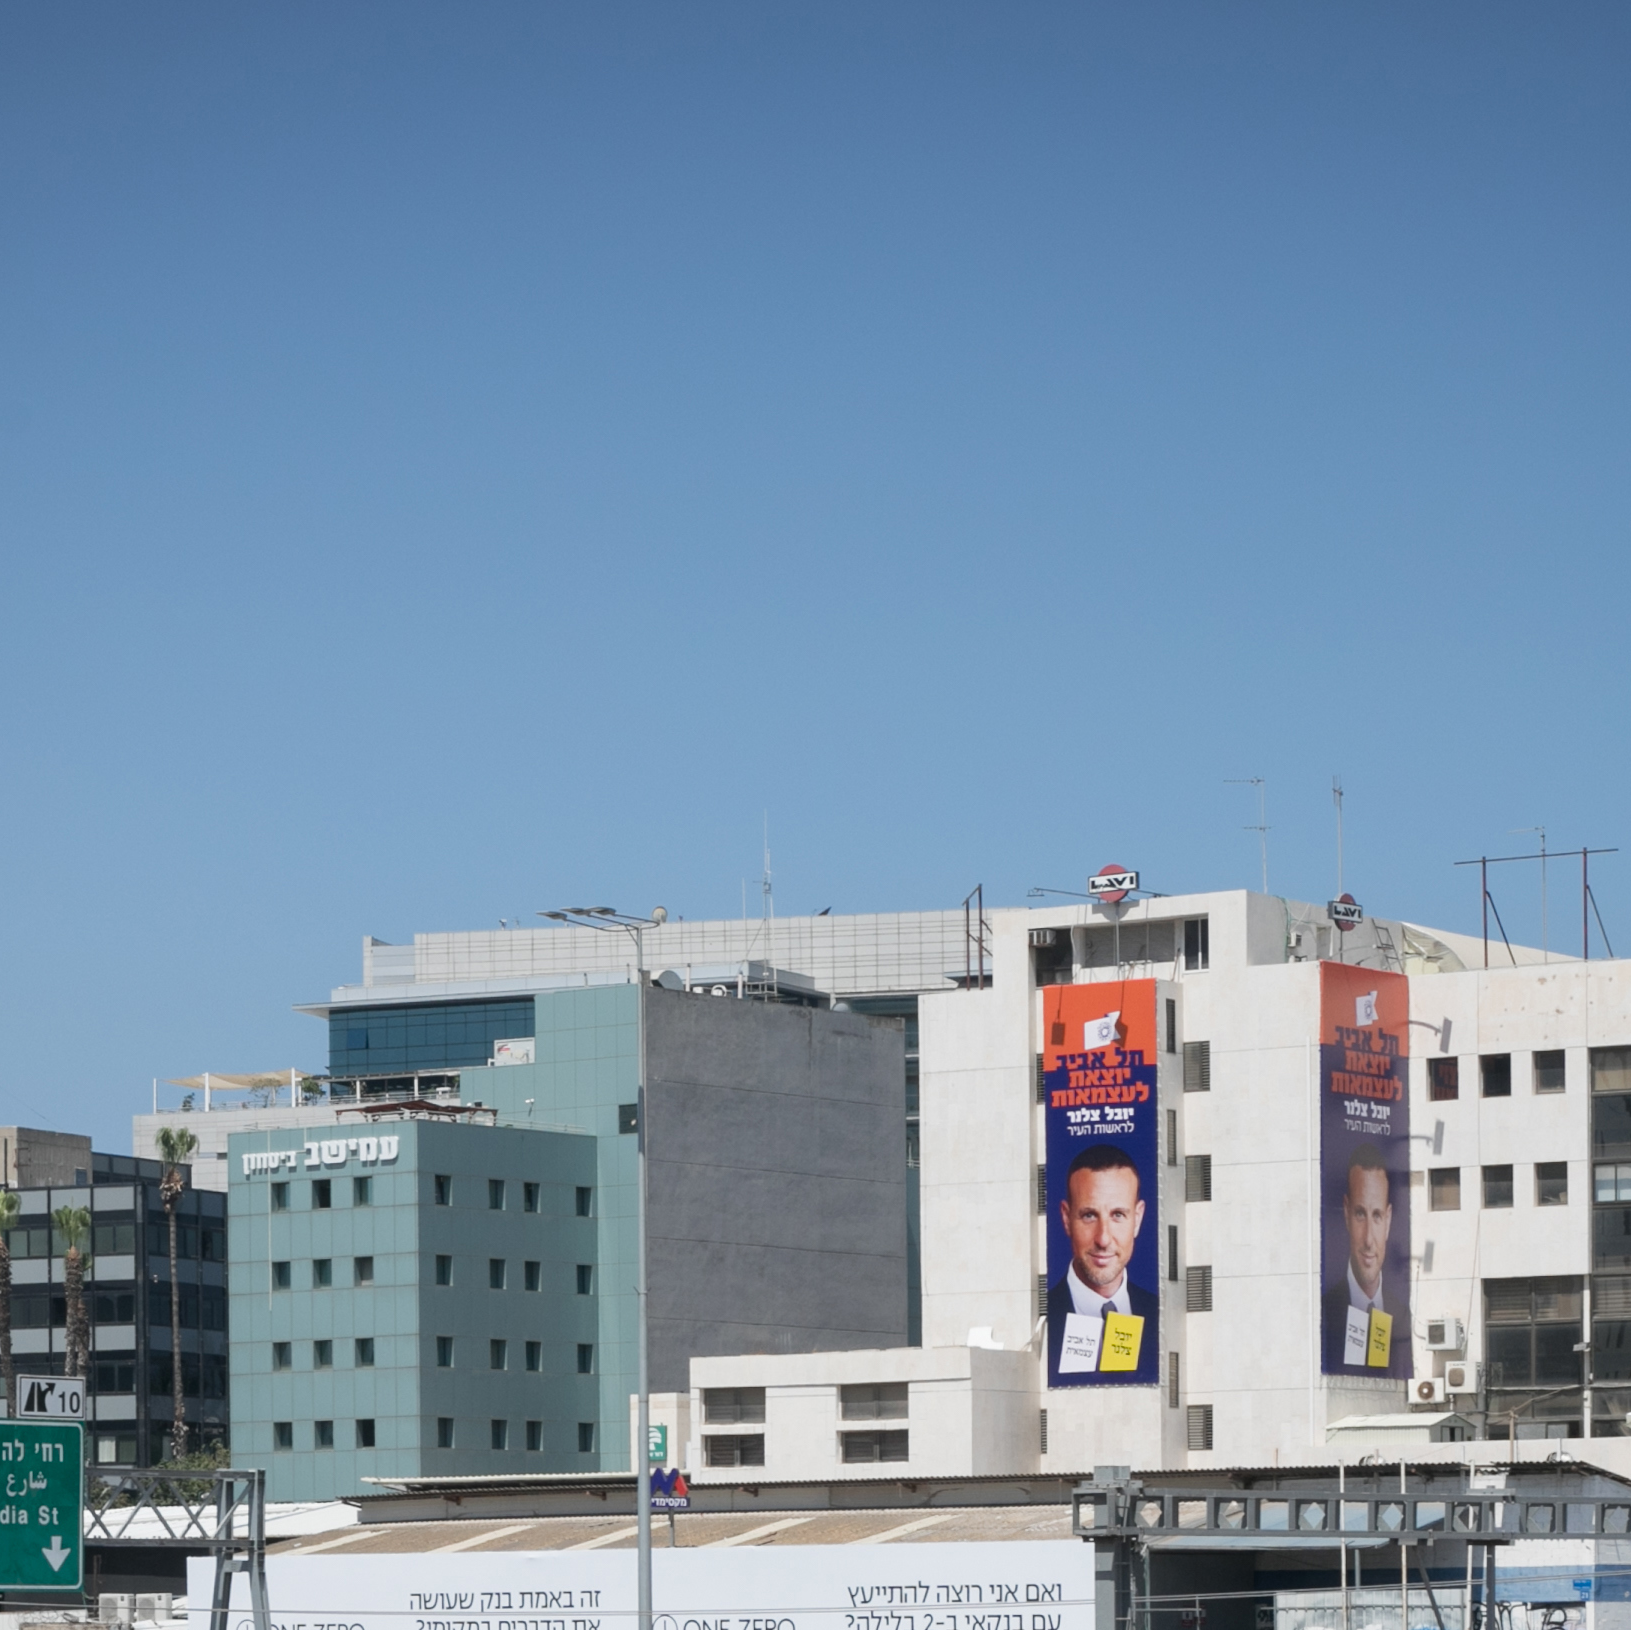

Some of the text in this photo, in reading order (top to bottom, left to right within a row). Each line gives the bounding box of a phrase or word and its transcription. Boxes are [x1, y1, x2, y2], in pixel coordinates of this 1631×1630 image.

[1090, 875, 1135, 891] LAVI
[1334, 905, 1362, 919] LAVI
[1335, 1026, 1399, 1054] תל אביב
[1055, 1047, 1144, 1070] תל אביב
[1345, 1050, 1390, 1075] יוצאת
[1069, 1067, 1131, 1087] יוצאת
[1331, 1071, 1403, 1101] לעצמאות
[1051, 1082, 1150, 1108] לעצמאות
[1066, 1105, 1134, 1123] יובל צלנר
[1344, 1099, 1391, 1118] יובל צלנר
[1067, 1120, 1134, 1136] לראשות העיר
[242, 1136, 399, 1175] עמישב ביטחון
[58, 1391, 81, 1413] 10
[2, 1438, 25, 1462] לה
[6, 1470, 48, 1497] شارع
[651, 1497, 687, 1507] מקסימדי
[38, 1505, 59, 1525] St
[410, 1589, 601, 1612] זה באמת בנק שעושה
[847, 1580, 1063, 1608] ואם אני רוצה להתייעץ
